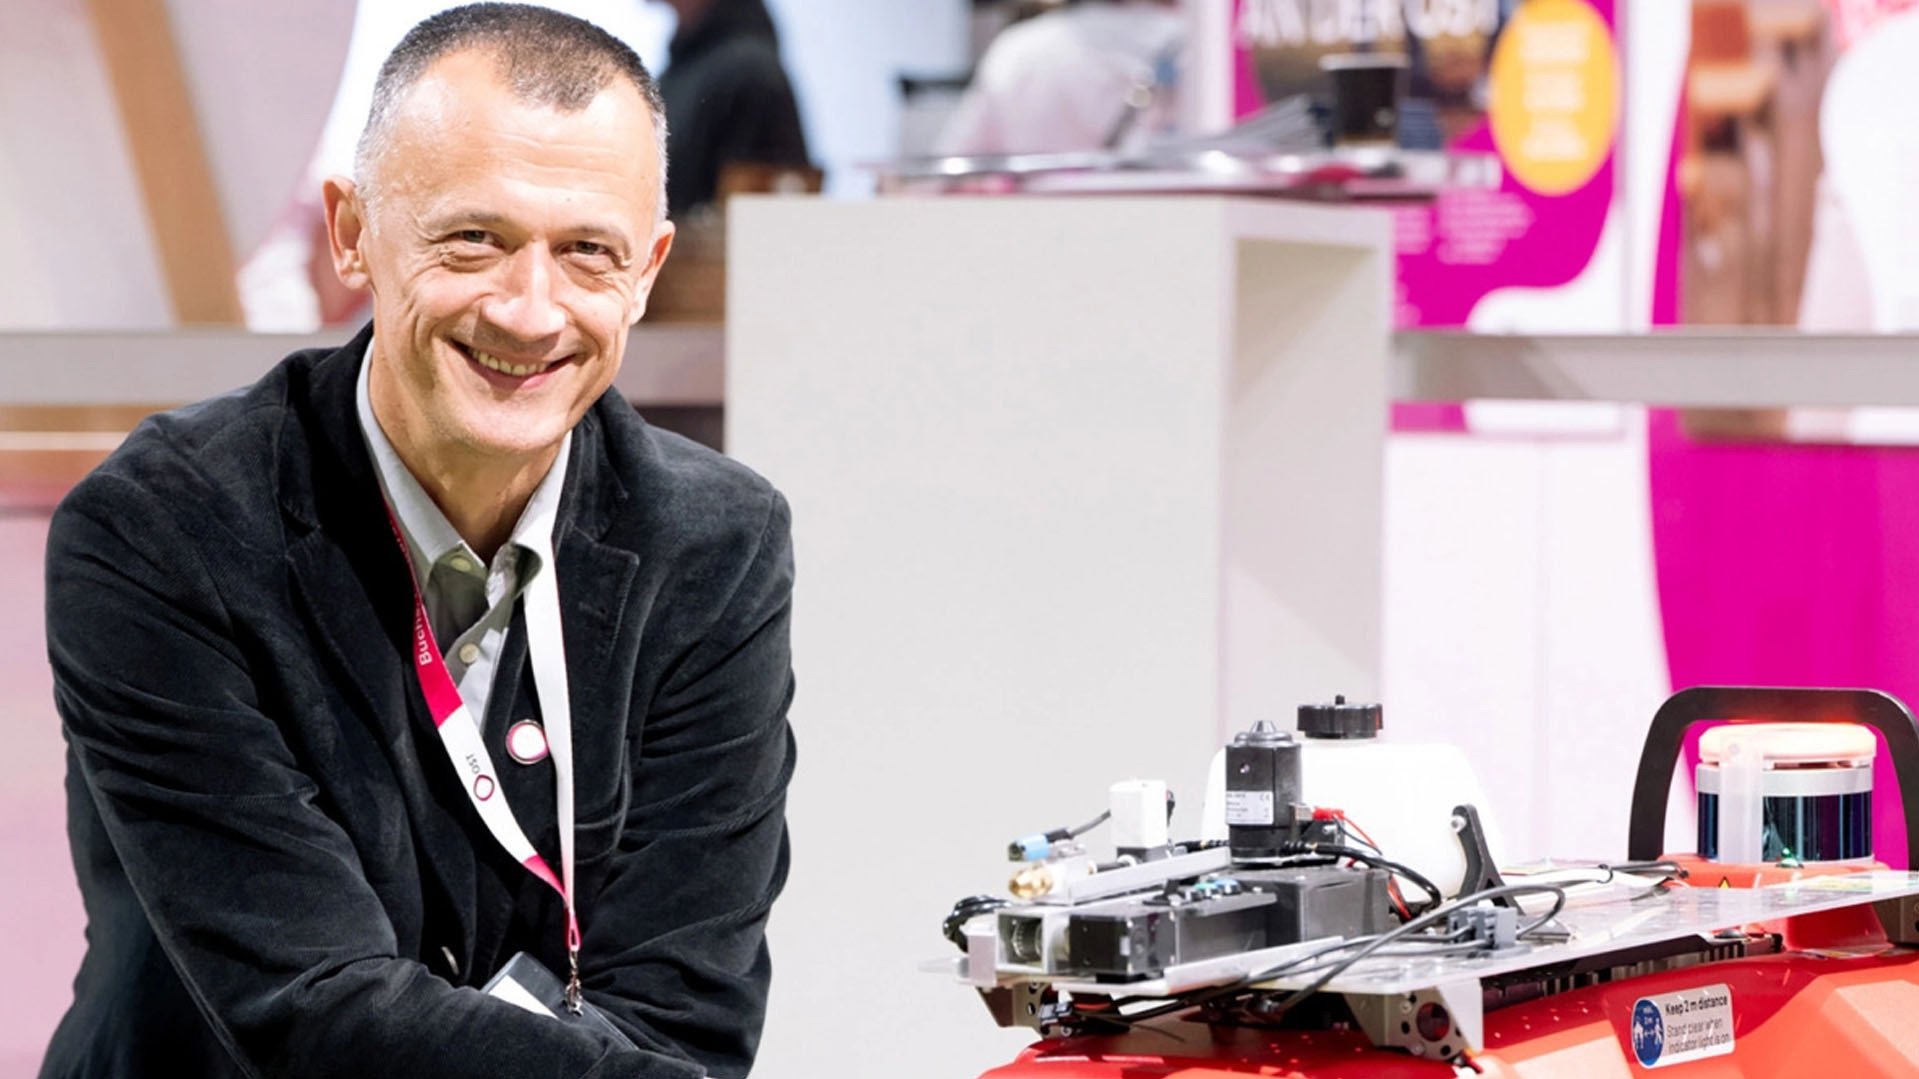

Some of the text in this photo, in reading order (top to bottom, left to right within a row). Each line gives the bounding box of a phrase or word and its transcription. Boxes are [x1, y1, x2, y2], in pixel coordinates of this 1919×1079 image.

[465, 753, 480, 775] OST
[1665, 1003, 1684, 1015] Keep
[1684, 1000, 1689, 1012] 2
[1690, 1001, 1697, 1010] m
[1698, 996, 1728, 1009] distance
